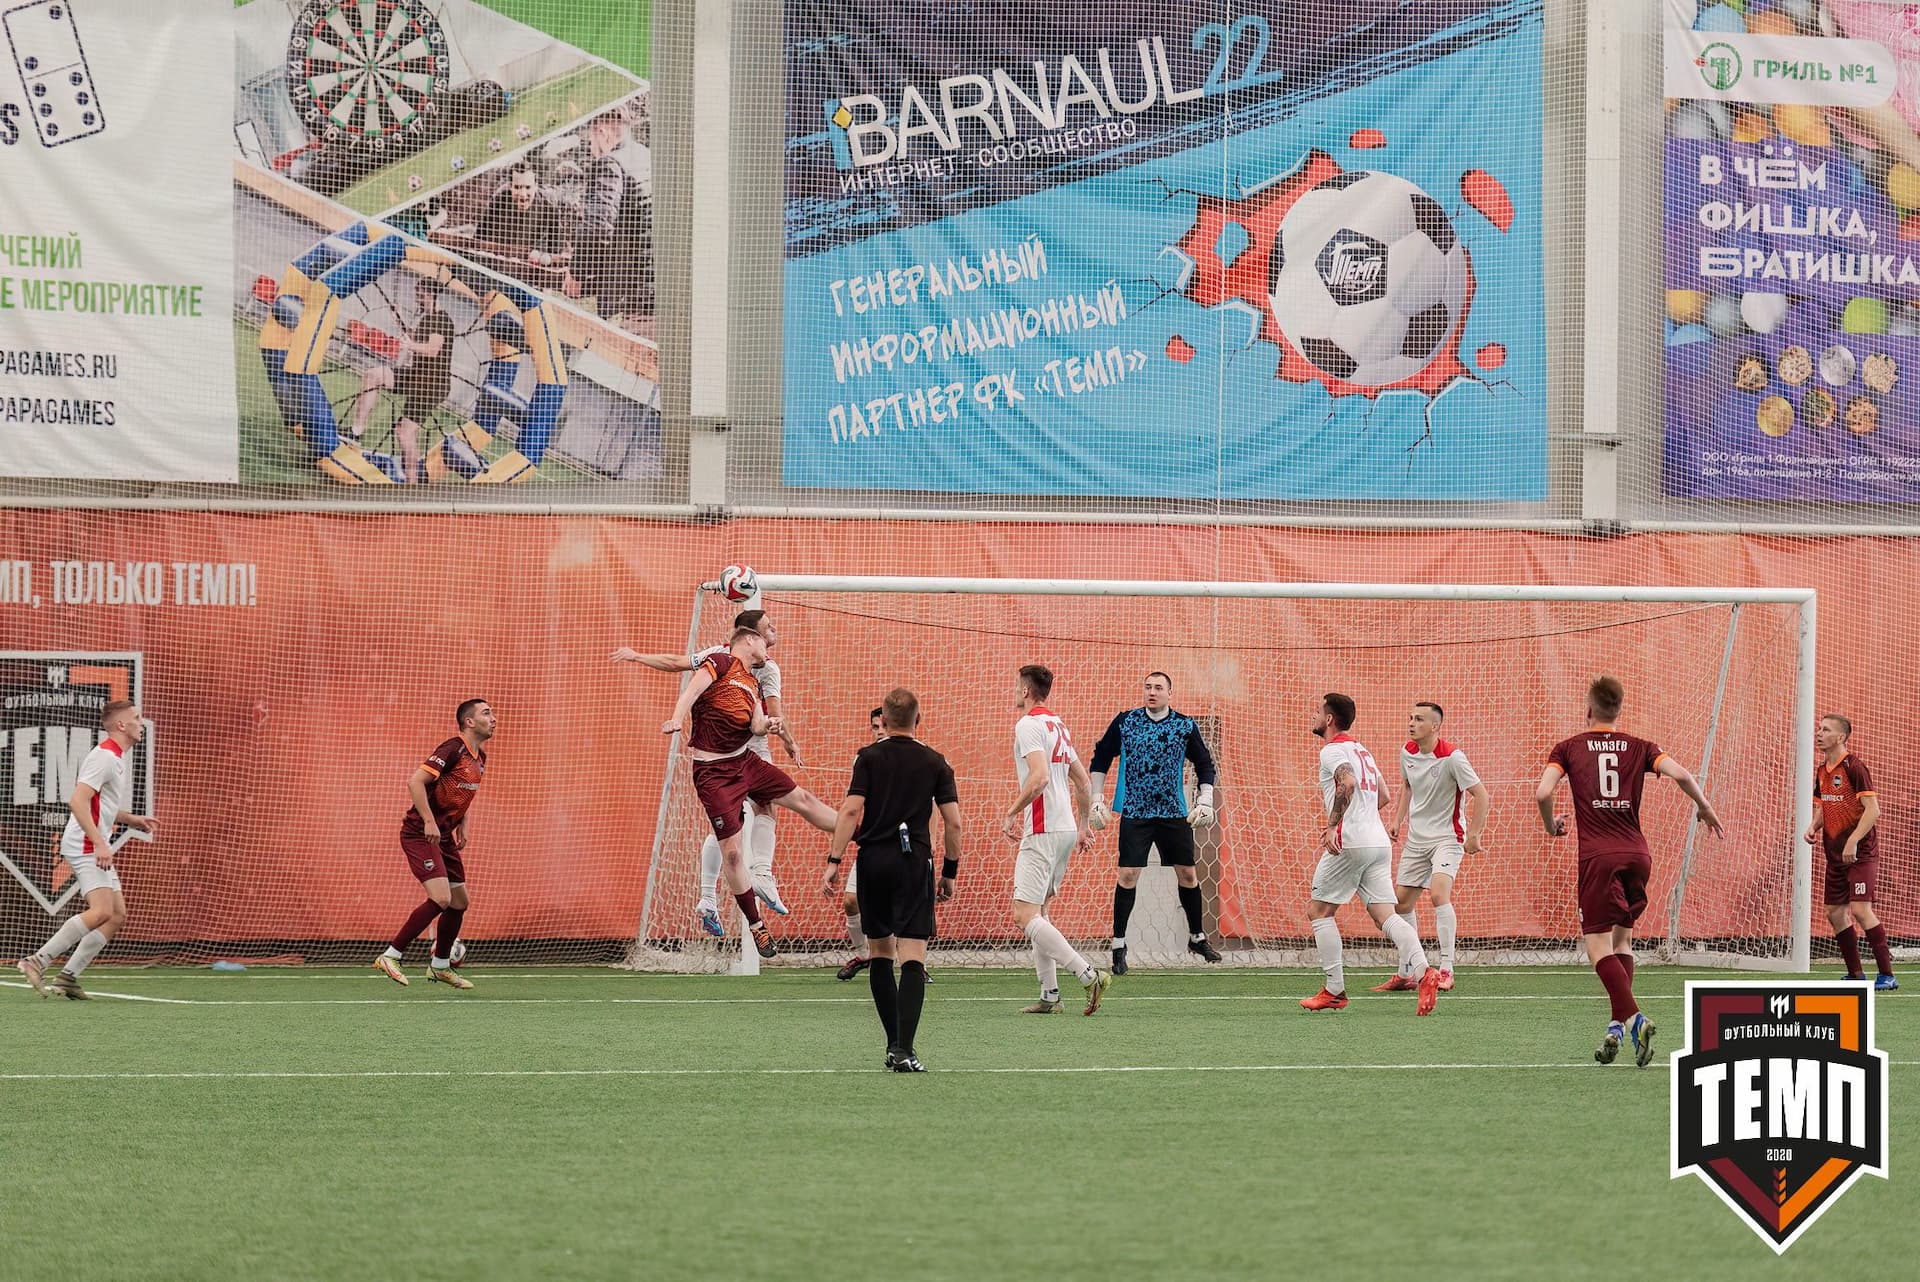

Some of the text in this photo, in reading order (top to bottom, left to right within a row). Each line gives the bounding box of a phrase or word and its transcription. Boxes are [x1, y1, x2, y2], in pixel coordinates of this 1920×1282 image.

[1753, 59, 1878, 84] ГРИЛЬ №1
[839, 154, 956, 194] ИНТЕРНЕТ
[978, 118, 1137, 168] СООБЩЕСТВО
[1701, 145, 1827, 191] В ЧЁМ
[1699, 202, 1877, 245] ФИШКА,
[830, 232, 1047, 317] ГЕНЕРАЛЬНЫЙ
[1700, 247, 1920, 285] БРАТИШКА
[21, 278, 203, 317] МЕРОПРИЯТИЕ
[830, 279, 1126, 384] ИНФОРМАЦИОННЫЙ
[828, 345, 1149, 444] ПАРТНЕР ФК «ТЕМП»
[50, 560, 162, 606] ТОЛЬКО
[172, 562, 257, 606] ТЕМП!
[1587, 739, 1628, 752] КНЯЗЕВ
[1353, 748, 1378, 793] 15
[1597, 753, 1620, 798] 6
[1592, 800, 1631, 809] SEUS
[1855, 882, 1866, 895] 20
